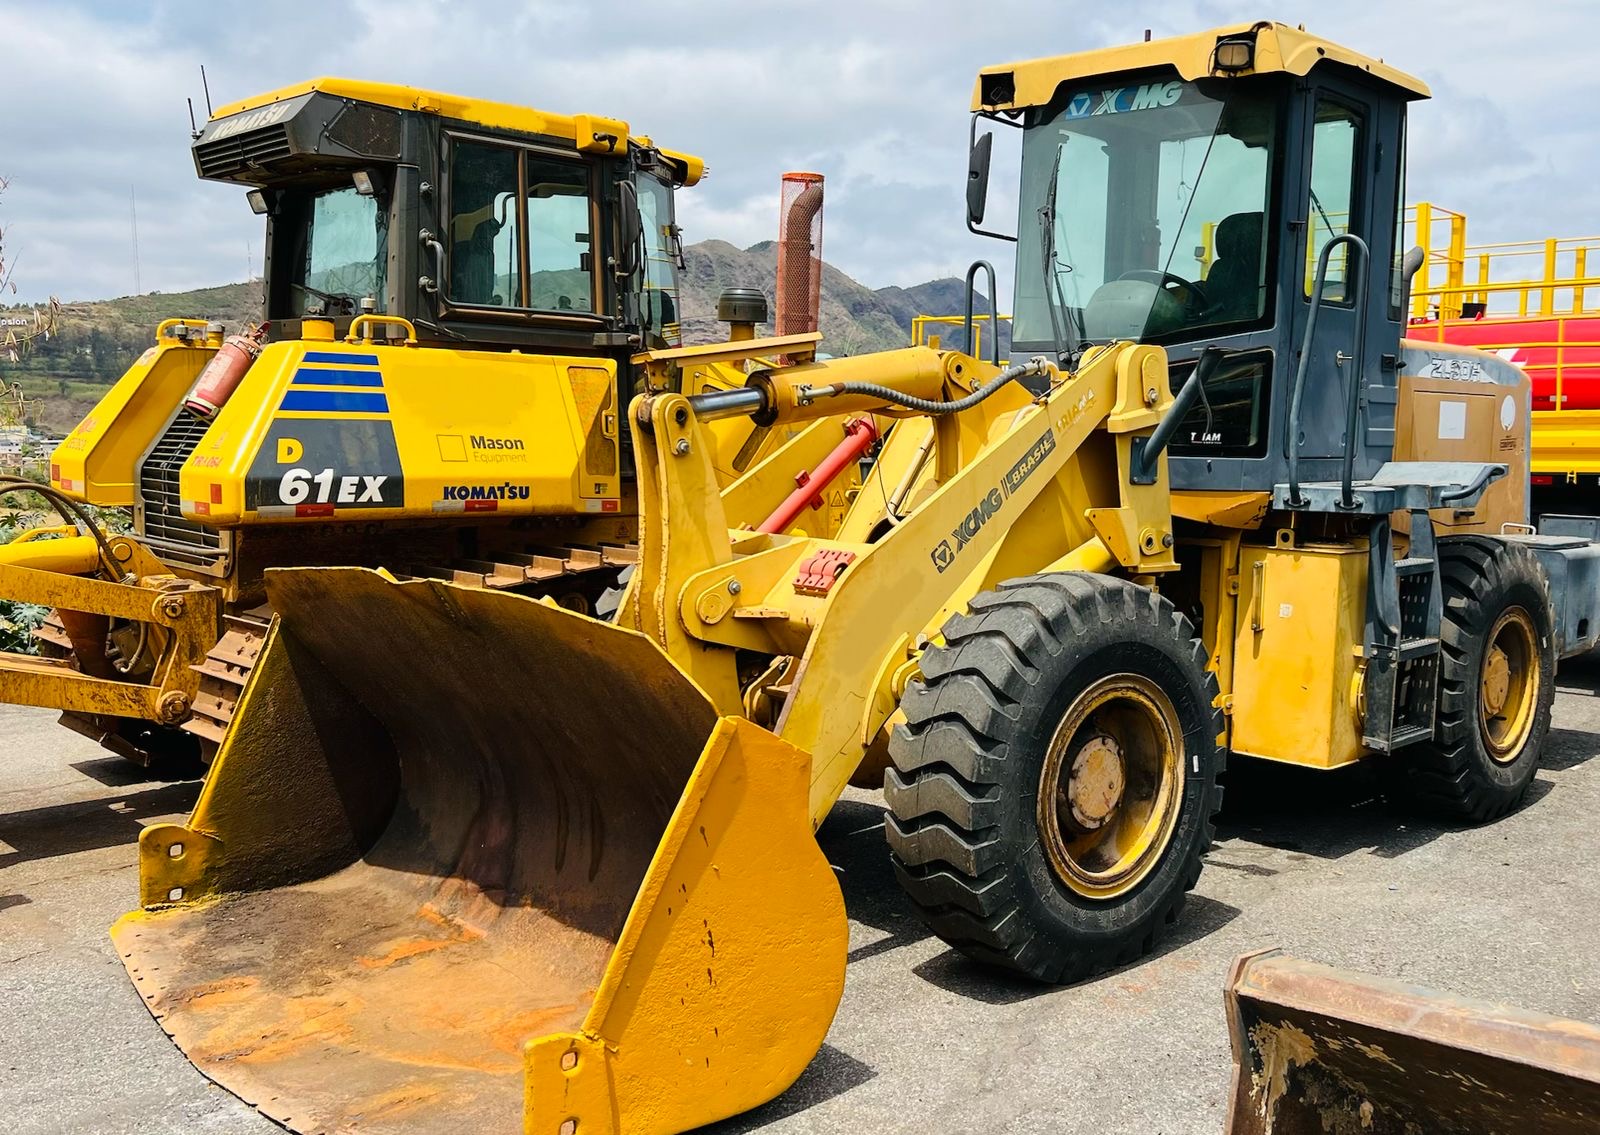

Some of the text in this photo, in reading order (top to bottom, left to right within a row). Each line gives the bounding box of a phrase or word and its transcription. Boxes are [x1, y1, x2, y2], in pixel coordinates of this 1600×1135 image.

[1090, 80, 1184, 117] XCMG
[208, 103, 292, 141] KOMATSU
[276, 437, 304, 464] D
[470, 435, 525, 450] Mason
[474, 452, 528, 464] Equipment
[443, 482, 530, 500] KOMATSU
[951, 437, 1054, 553] XCMG BRASIL
